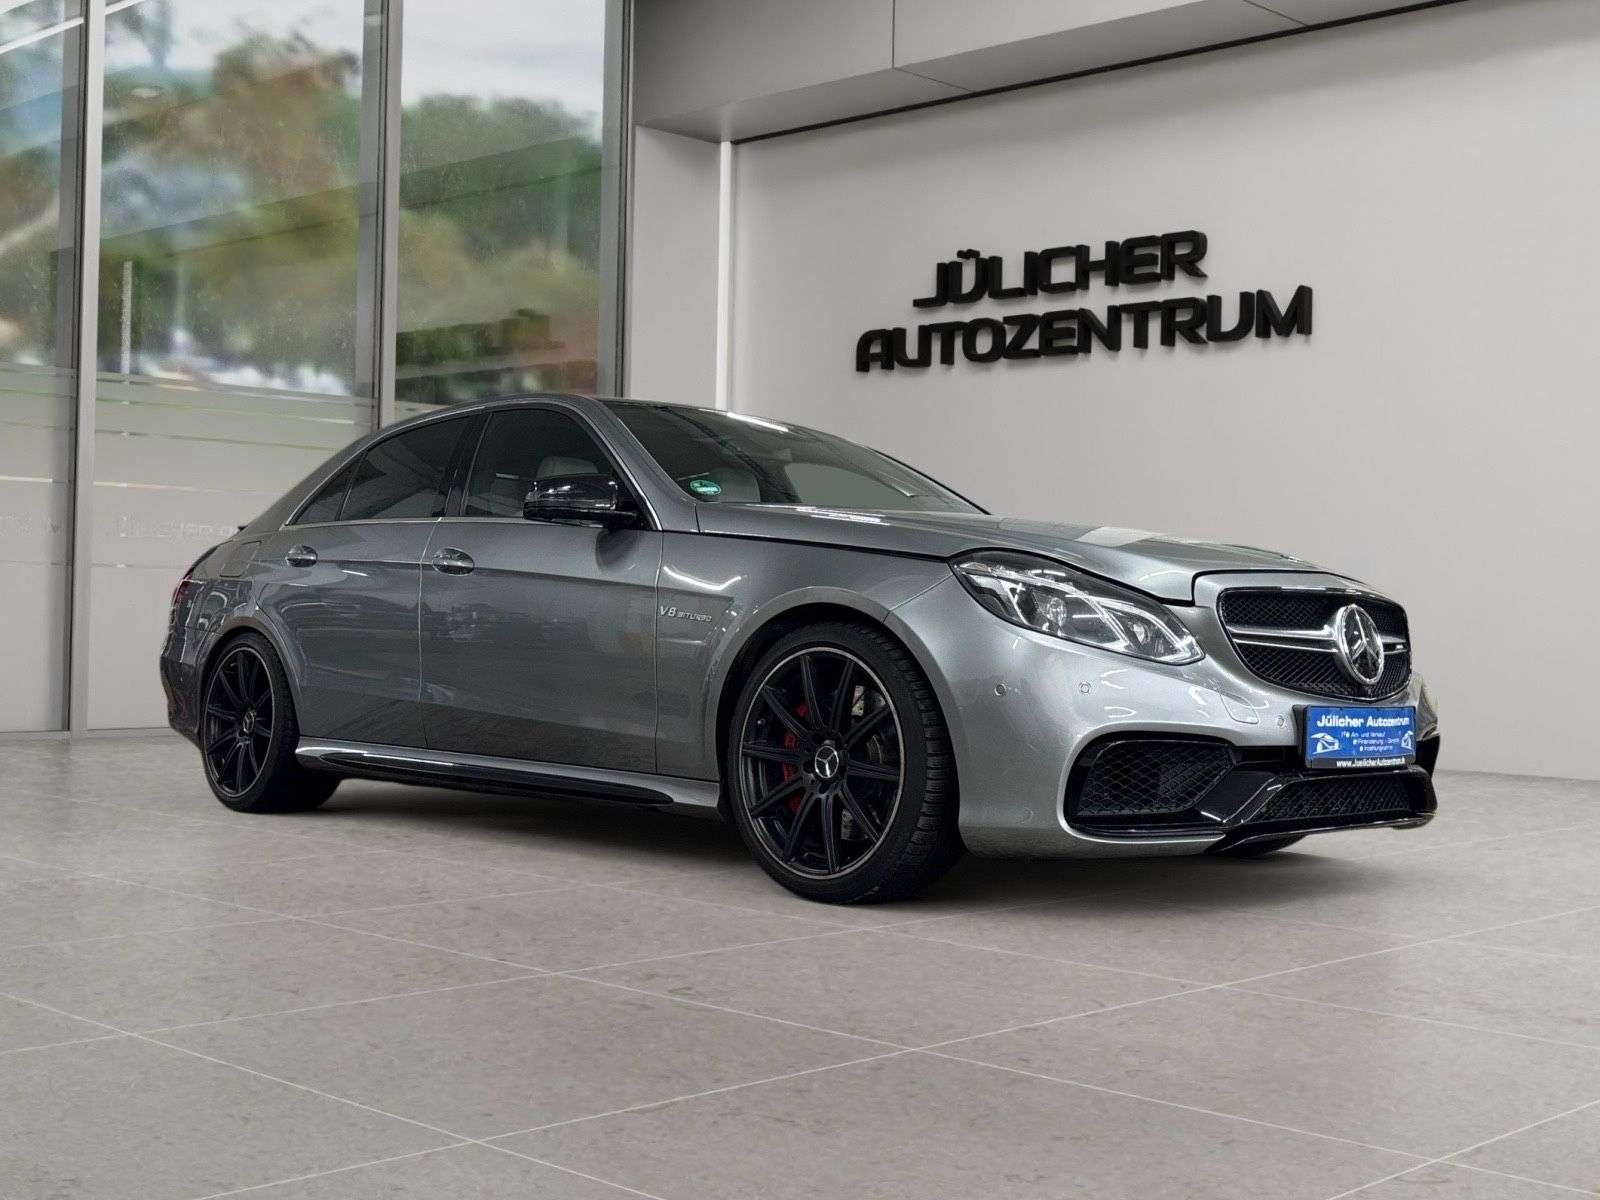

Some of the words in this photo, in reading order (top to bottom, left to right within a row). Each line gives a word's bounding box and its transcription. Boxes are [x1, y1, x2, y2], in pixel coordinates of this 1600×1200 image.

[913, 230, 1208, 308] JÜLICHER
[856, 285, 1312, 372] AUTOZENTRUM
[660, 606, 676, 617] V8
[677, 611, 712, 622] BITURBO
[1317, 714, 1364, 727] Jülicher
